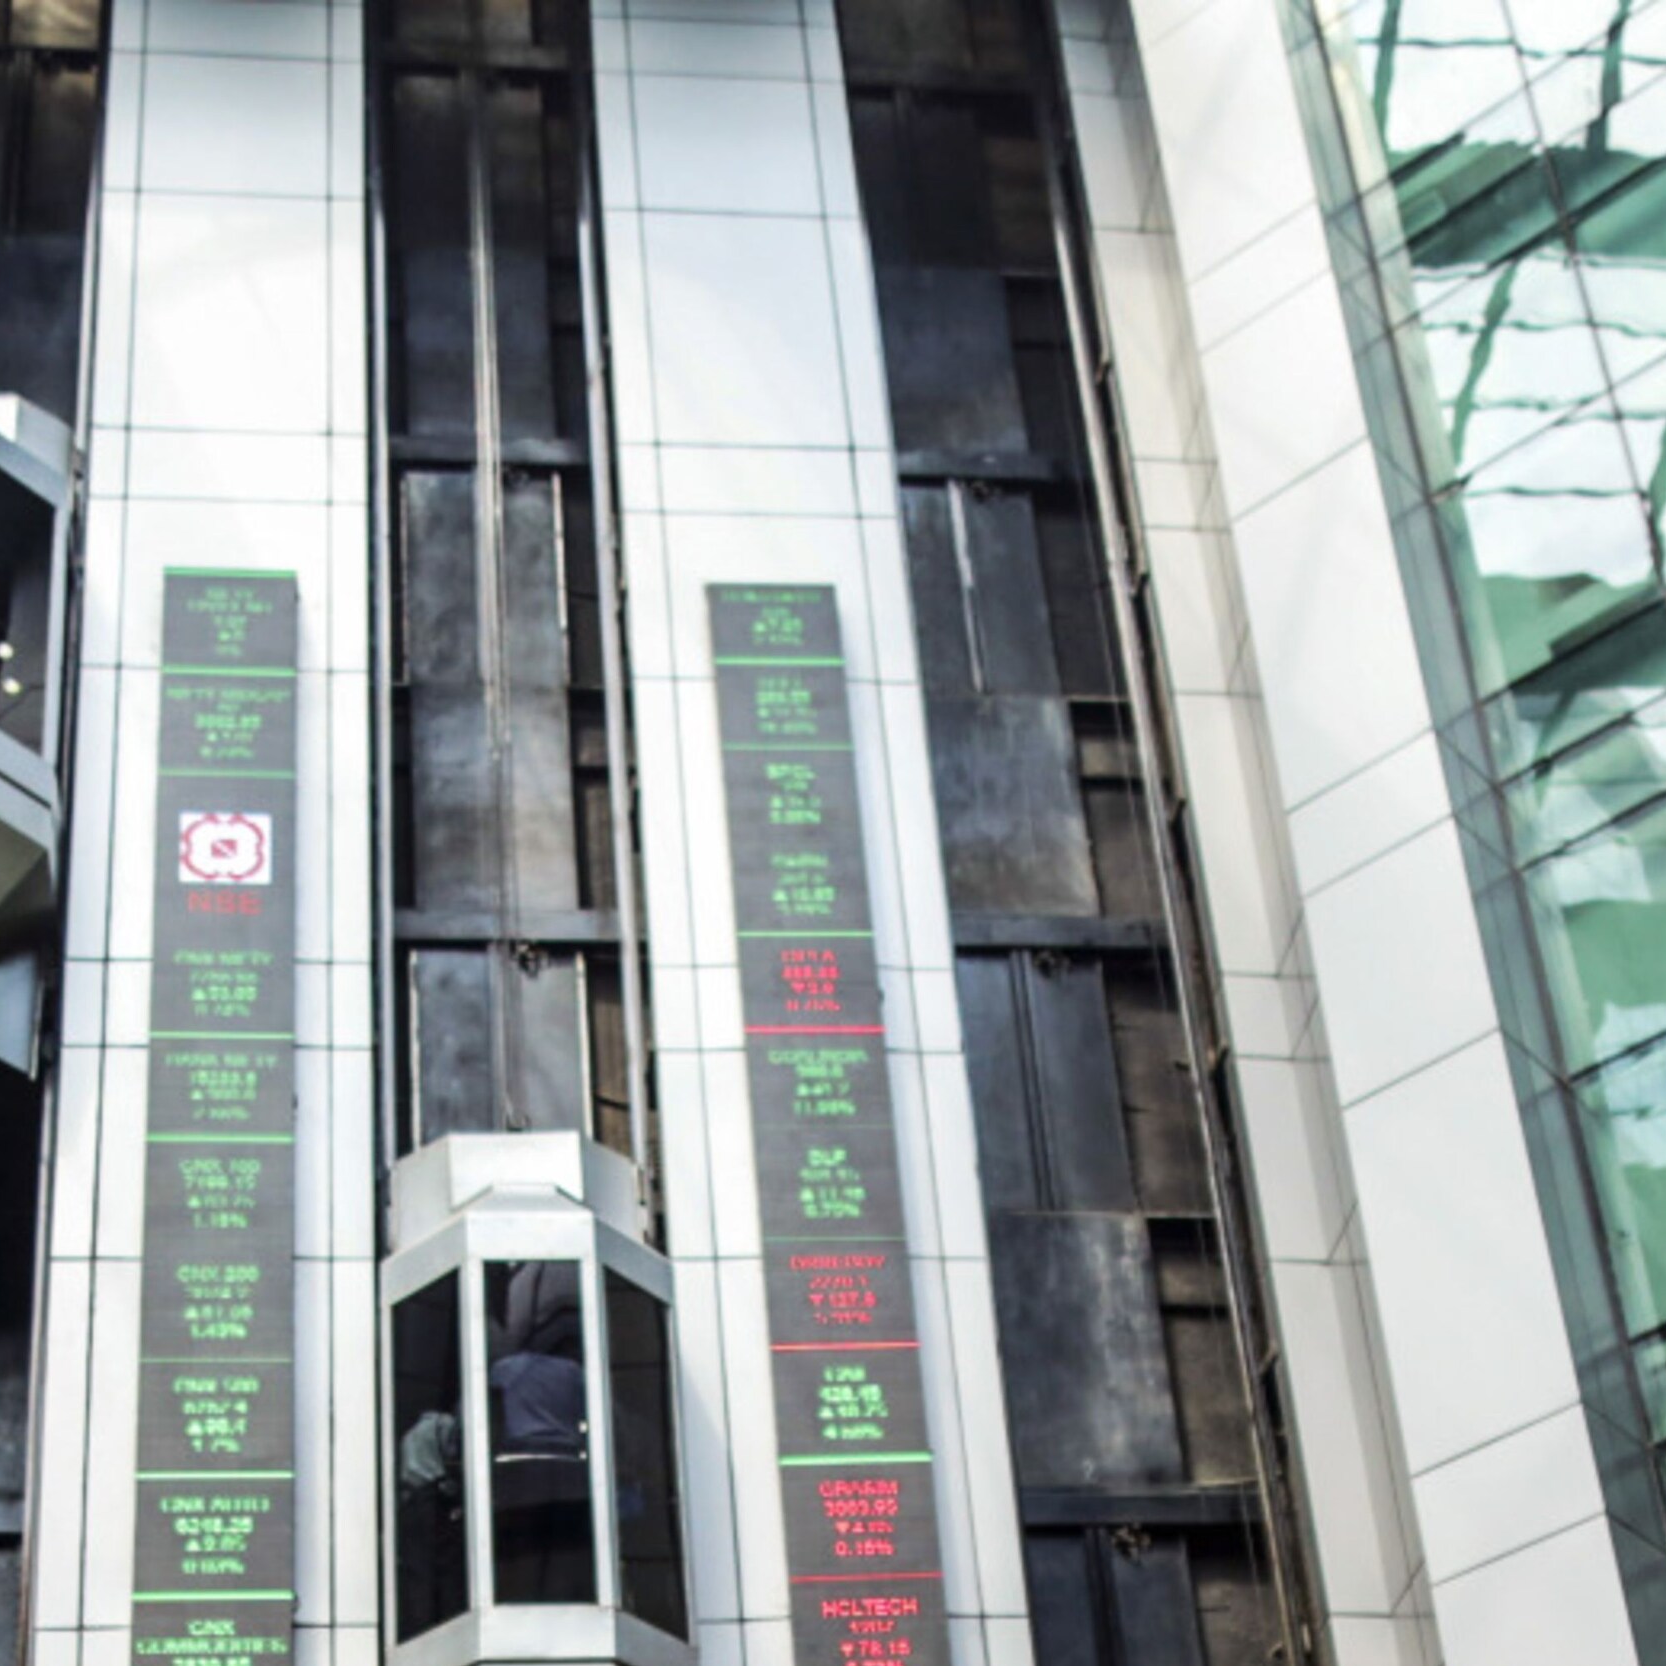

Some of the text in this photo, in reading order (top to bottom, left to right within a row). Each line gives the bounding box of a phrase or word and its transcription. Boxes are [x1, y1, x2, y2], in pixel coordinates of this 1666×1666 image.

[188, 889, 264, 915] NSE
[821, 1600, 919, 1619] HCLTECH
[187, 1618, 236, 1637] CNX
